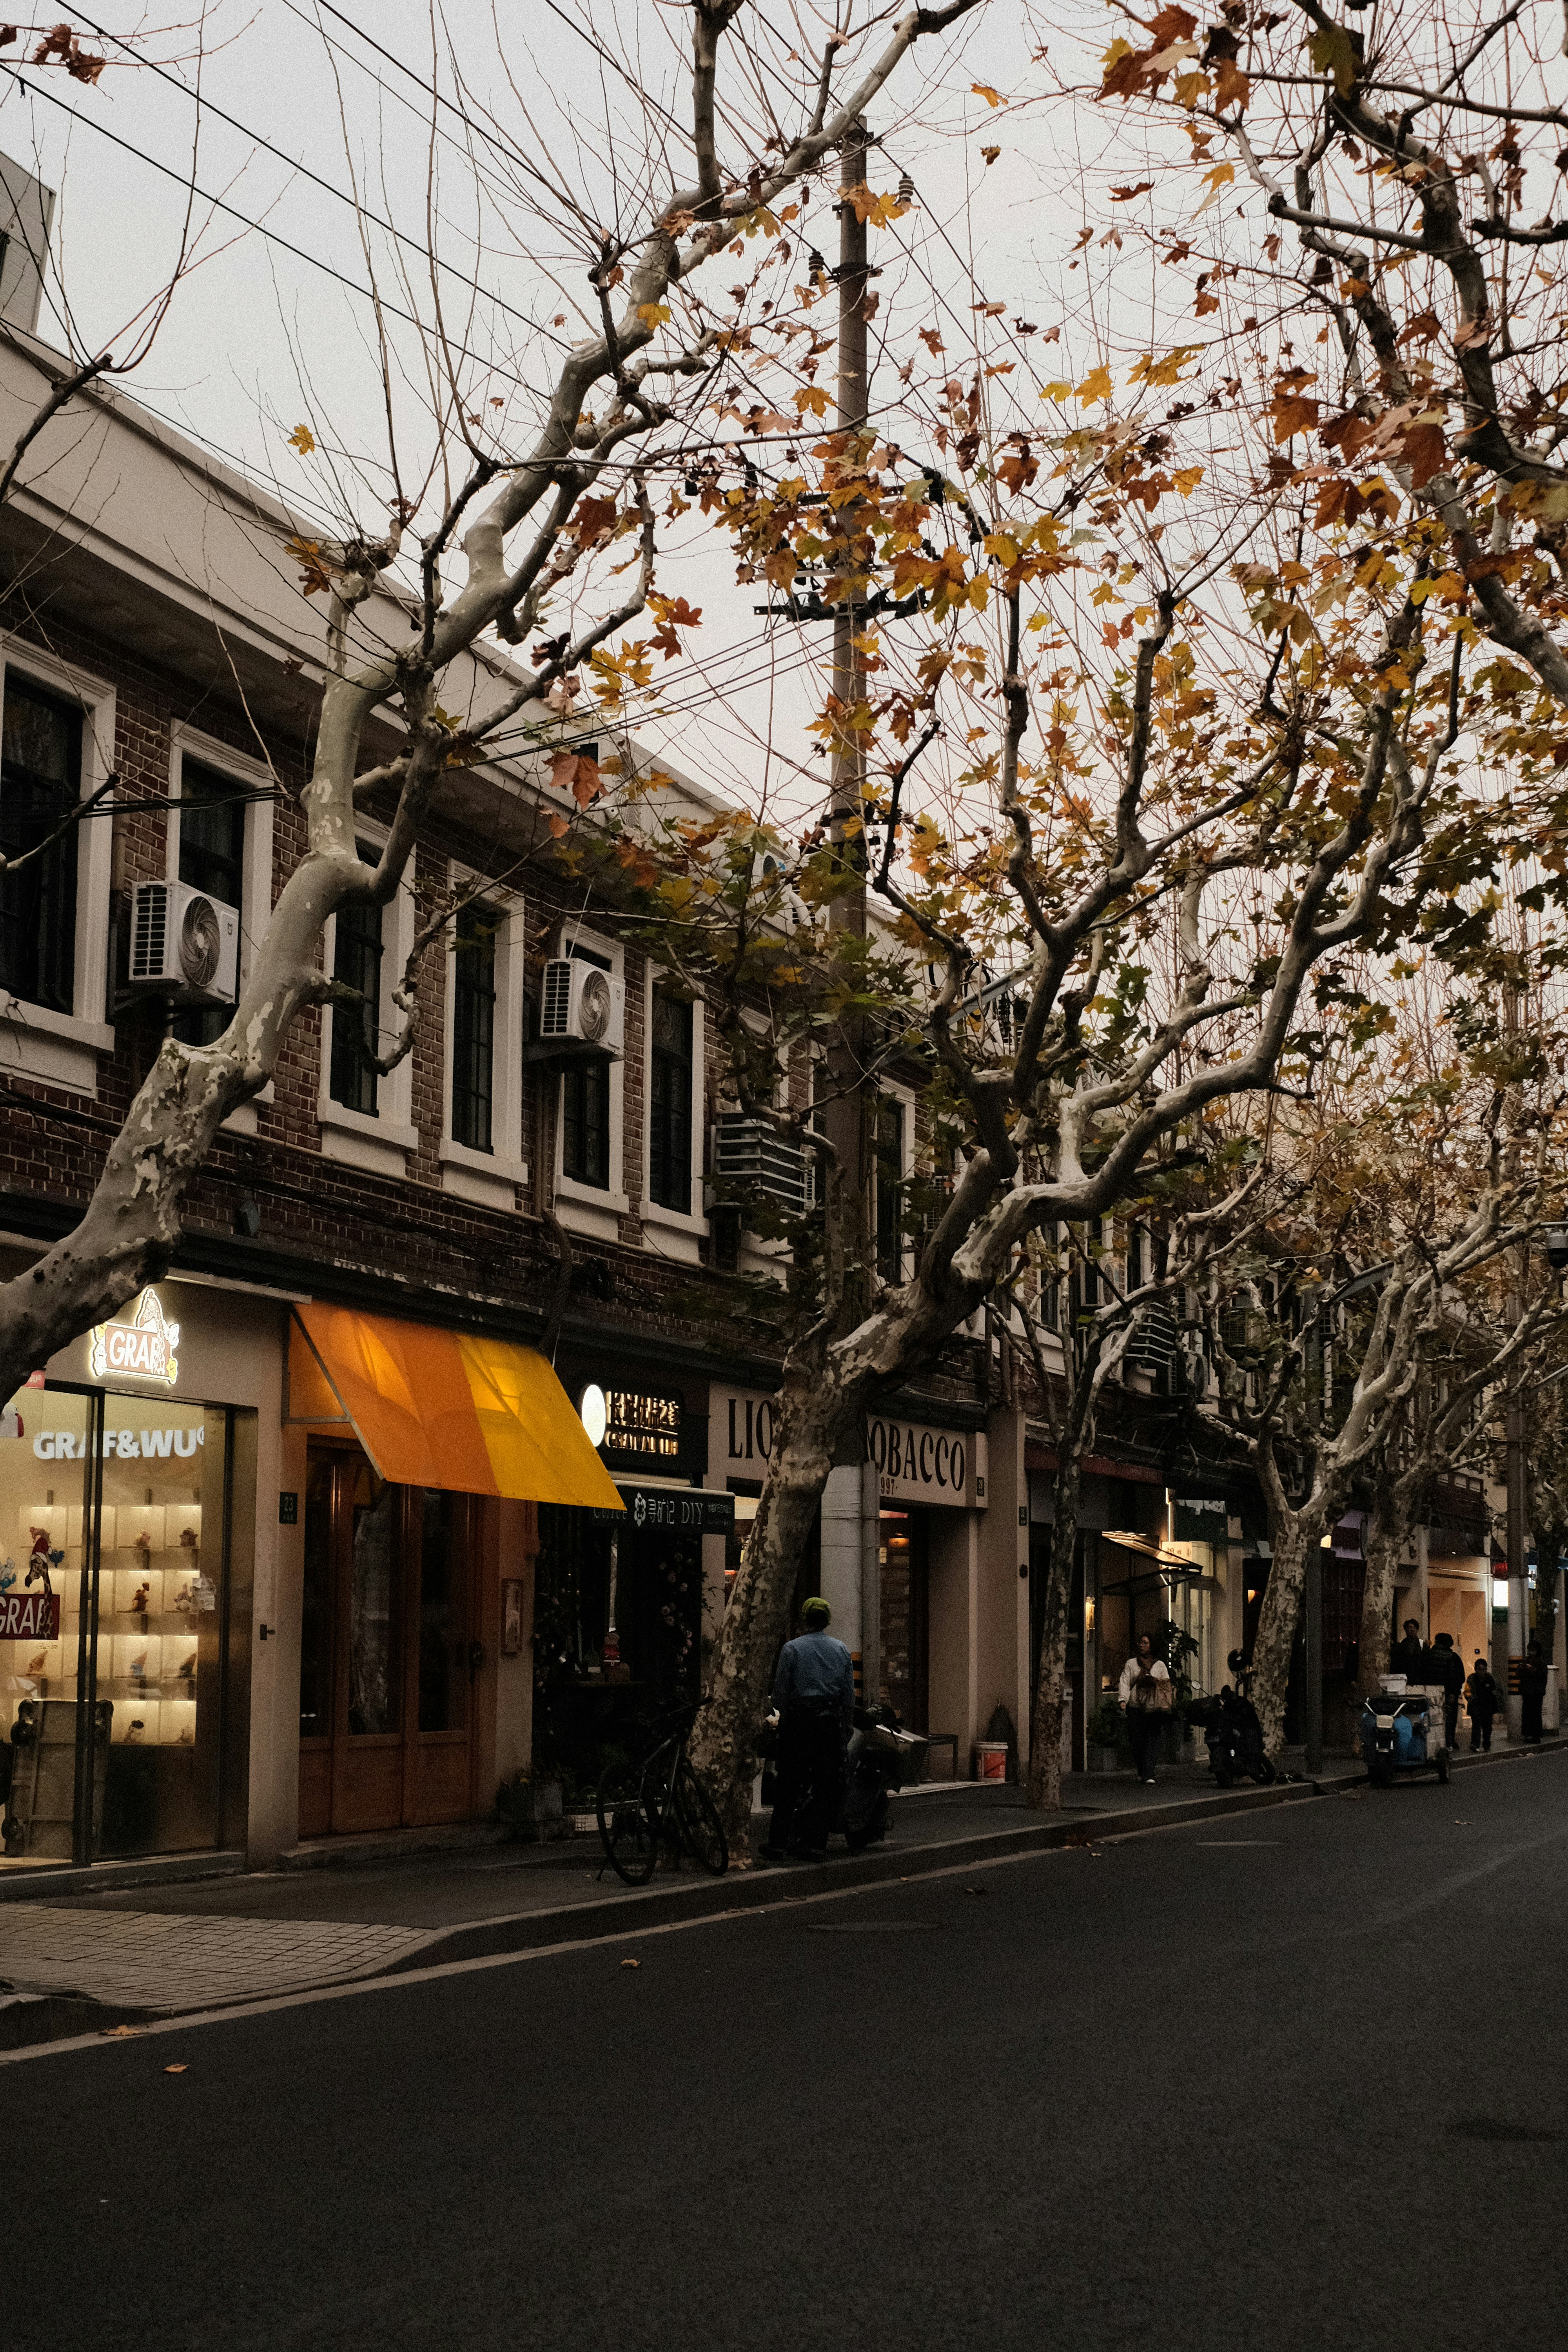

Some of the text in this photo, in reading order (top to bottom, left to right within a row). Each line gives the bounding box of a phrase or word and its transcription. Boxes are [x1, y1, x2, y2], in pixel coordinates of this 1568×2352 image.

[870, 1420, 964, 1491] OBACCO
[284, 1496, 294, 1512] 23
[648, 1499, 675, 1524] 寻矿记
[681, 1501, 703, 1524] DIY
